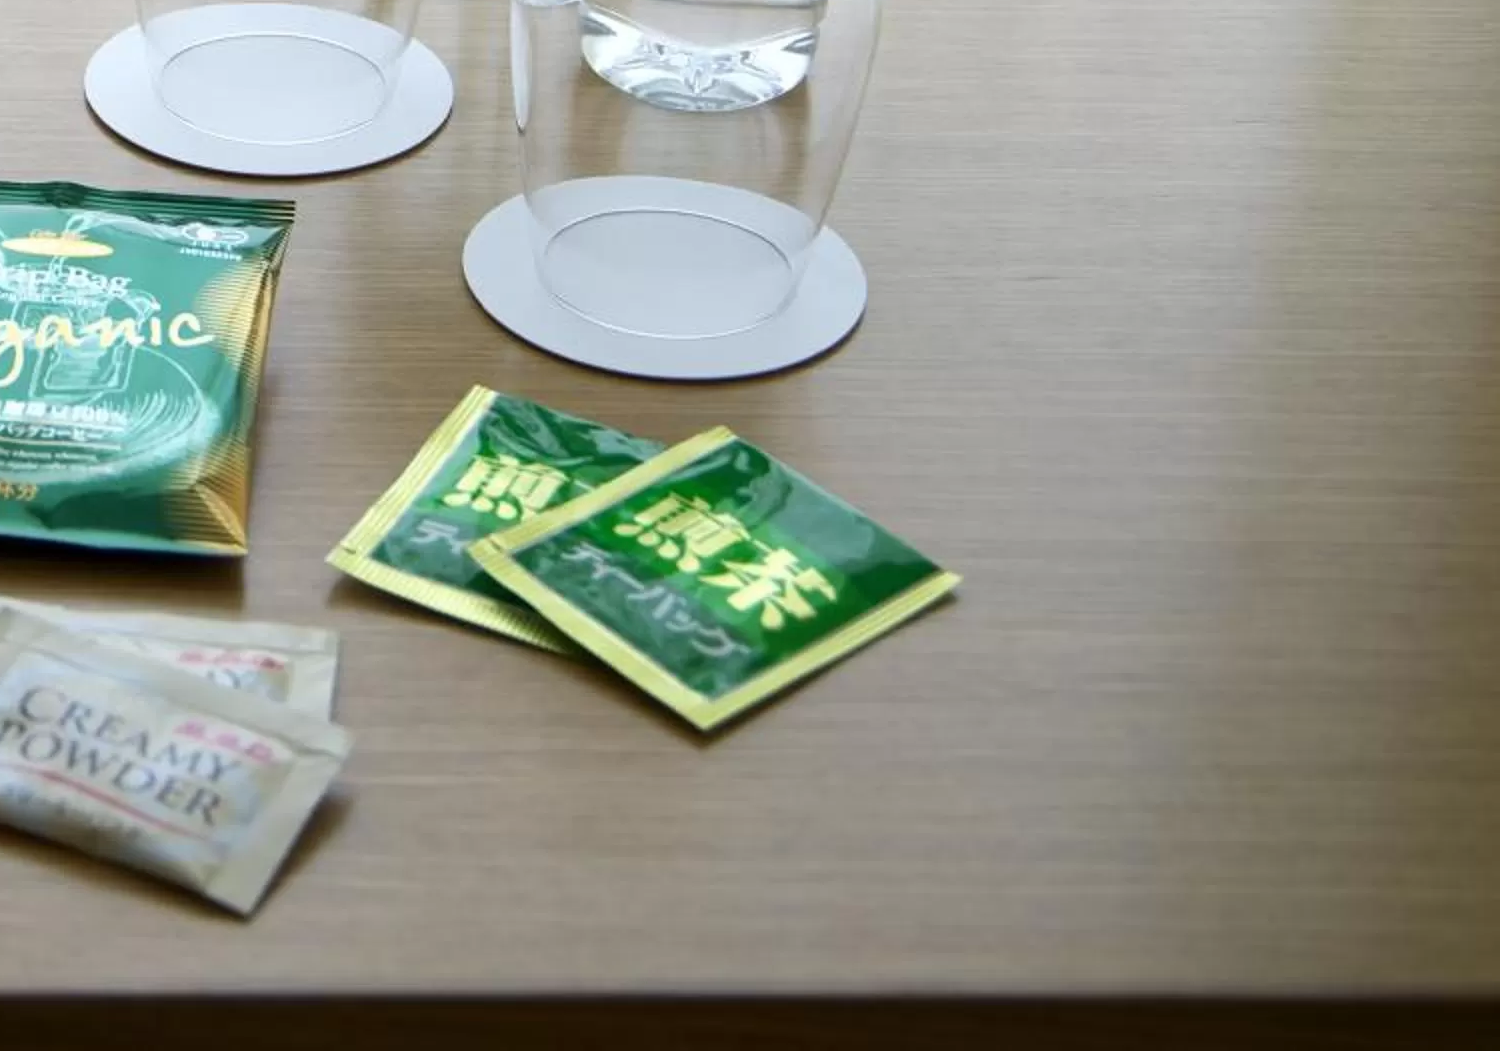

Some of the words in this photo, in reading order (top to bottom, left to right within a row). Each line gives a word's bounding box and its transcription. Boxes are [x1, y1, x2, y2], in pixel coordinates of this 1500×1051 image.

[561, 541, 750, 656] ティーバッグ
[613, 491, 837, 630] 煎茶
[18, 685, 242, 782] CREAMY
